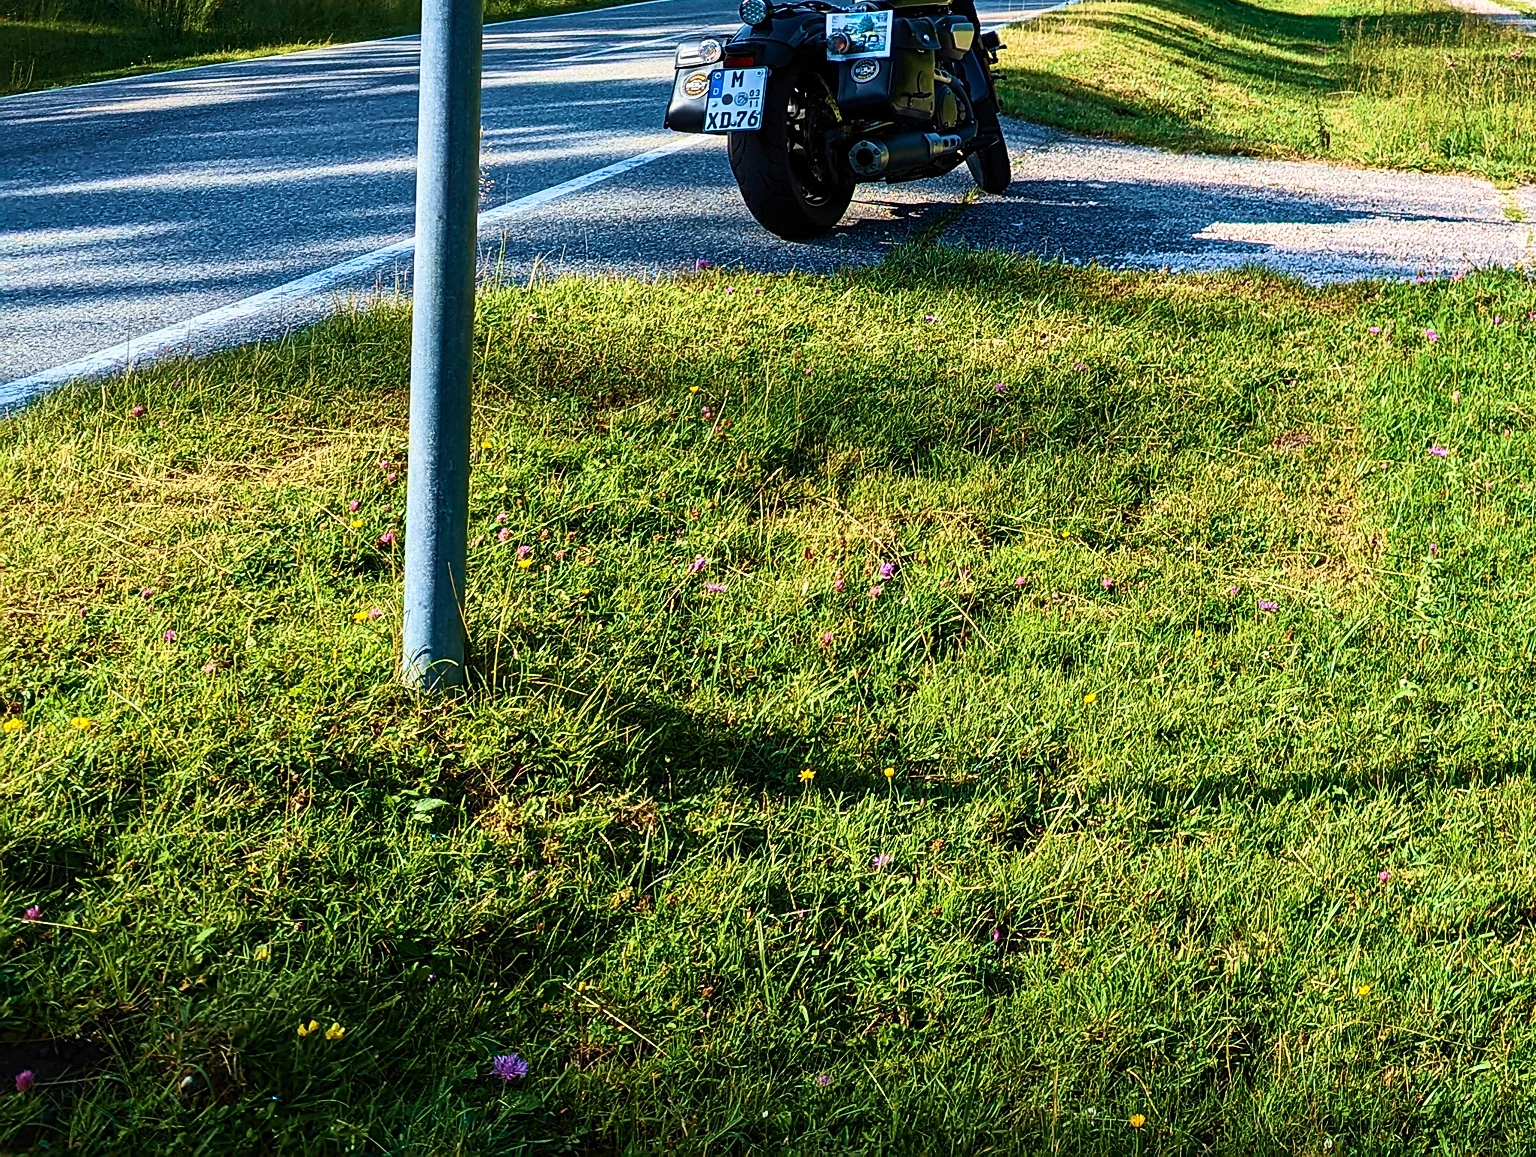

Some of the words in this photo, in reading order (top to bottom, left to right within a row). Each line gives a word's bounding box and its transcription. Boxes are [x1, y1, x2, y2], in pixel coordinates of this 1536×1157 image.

[731, 70, 744, 88] M
[713, 87, 719, 95] D
[749, 89, 760, 97] 03
[706, 111, 732, 129] XD
[736, 110, 759, 128] 76
